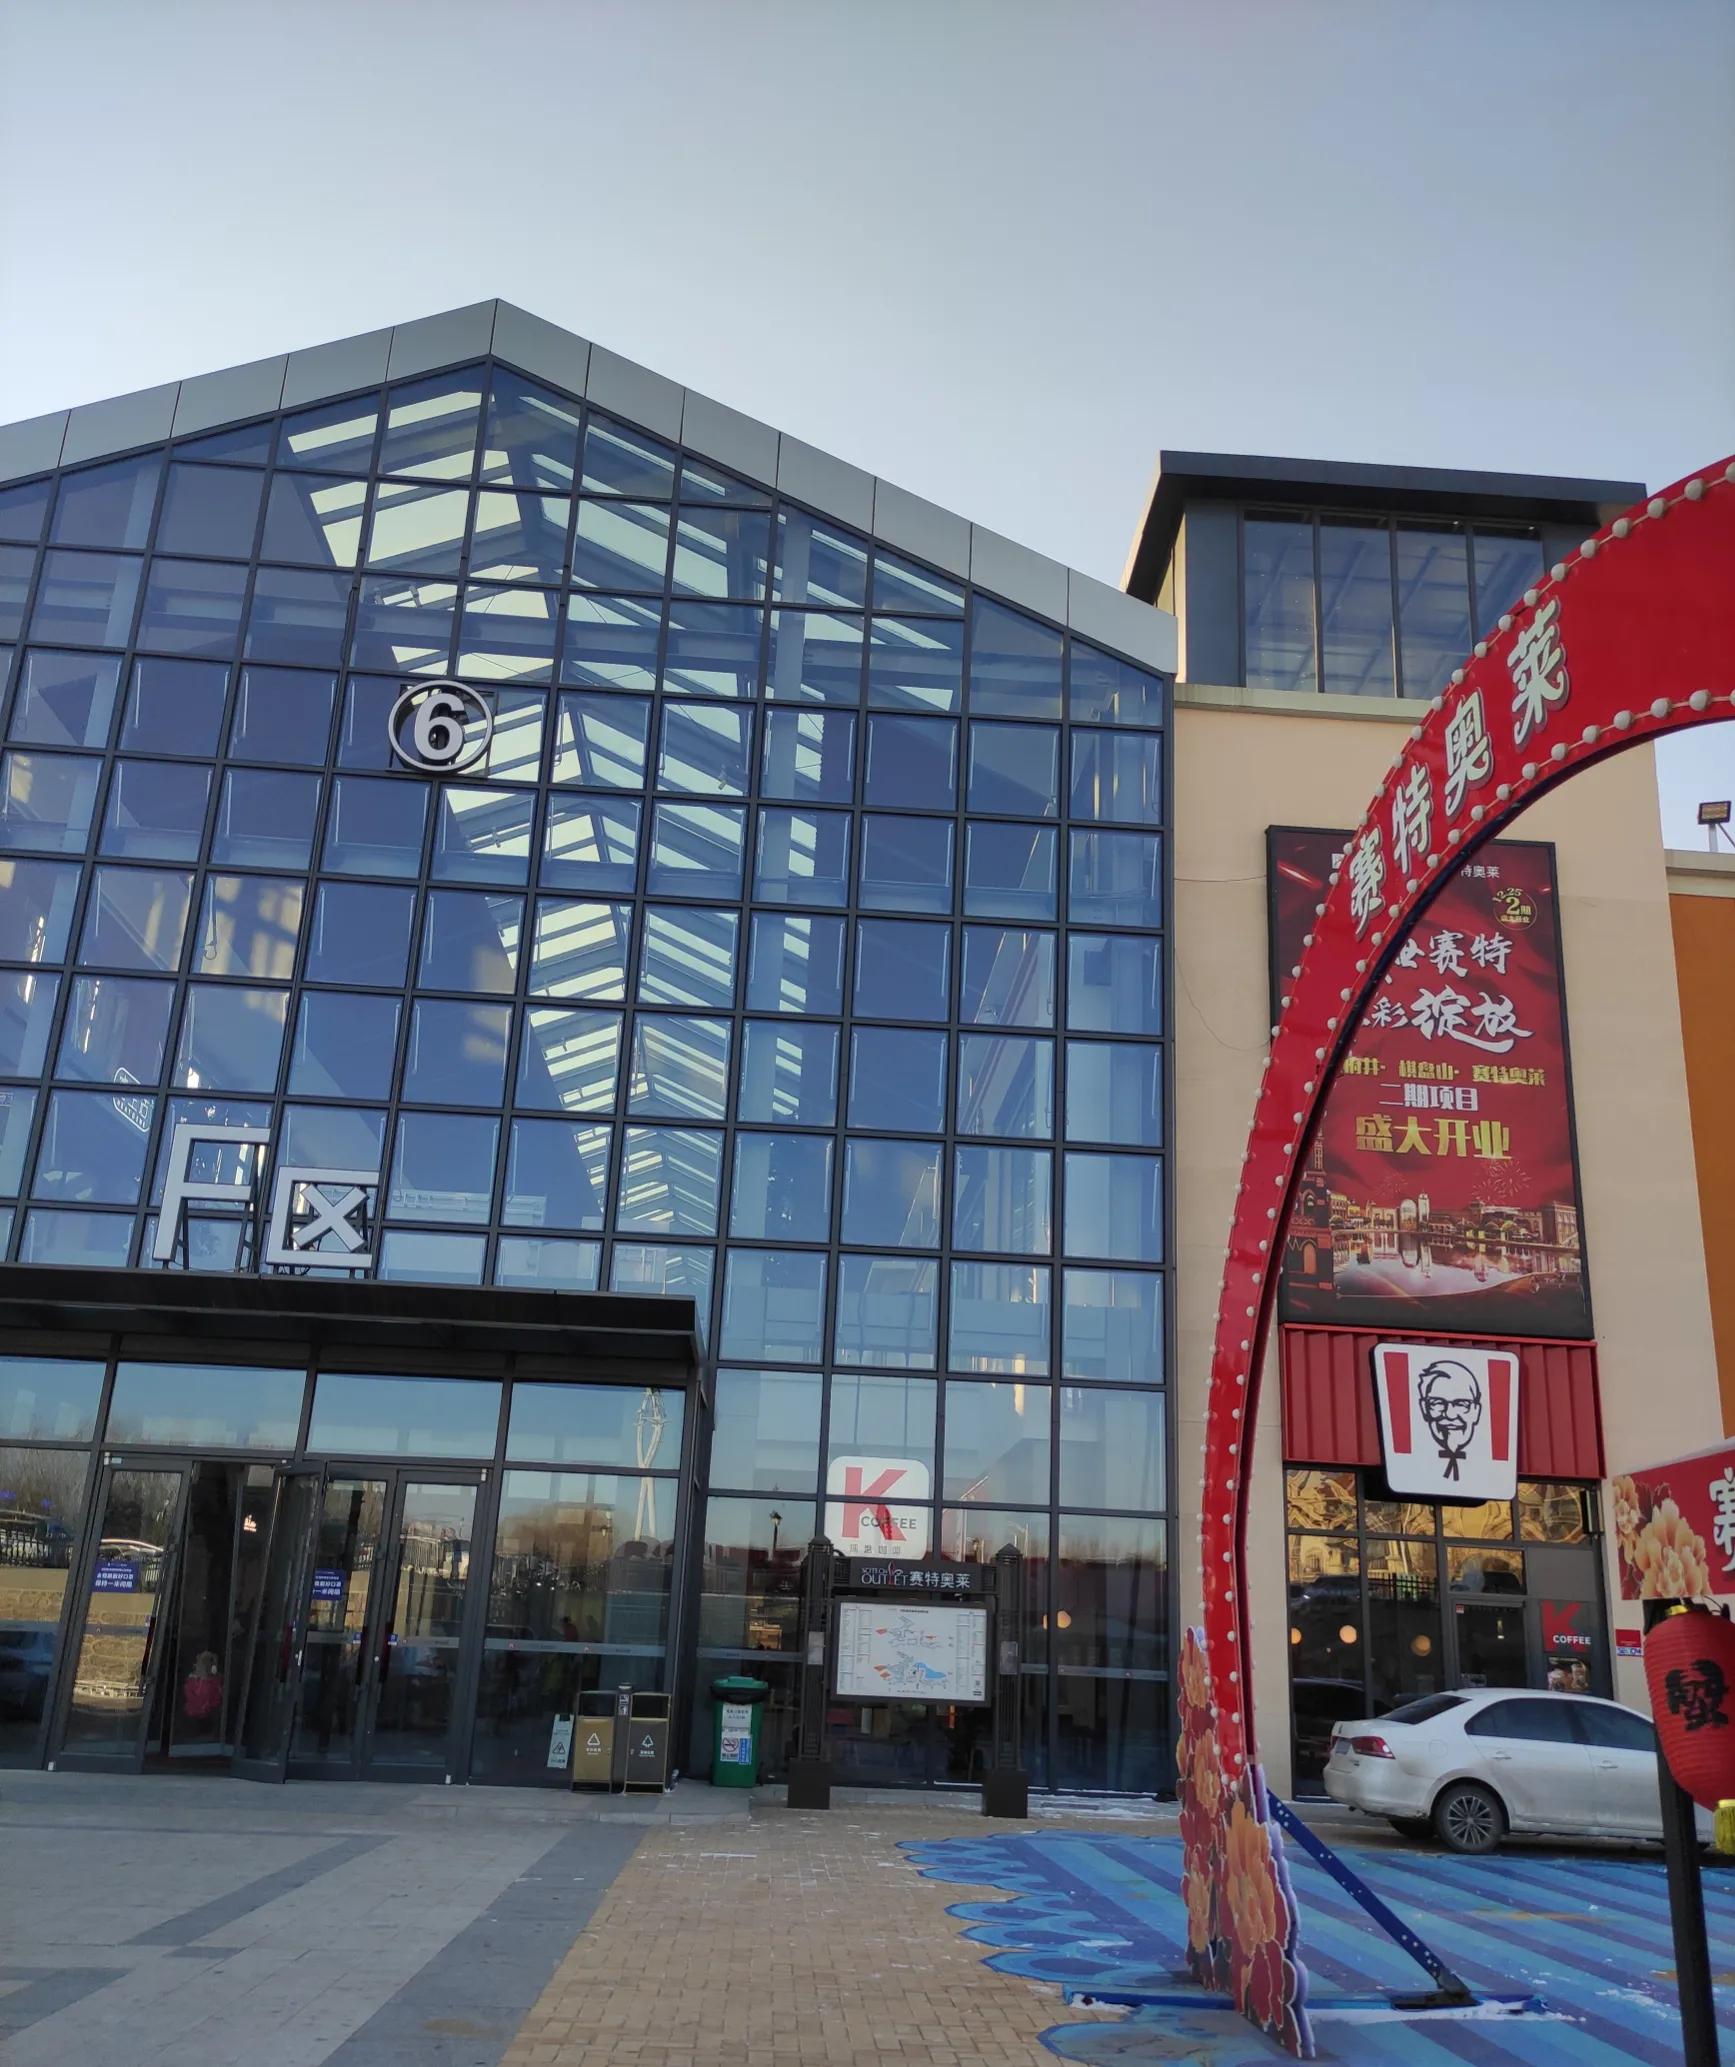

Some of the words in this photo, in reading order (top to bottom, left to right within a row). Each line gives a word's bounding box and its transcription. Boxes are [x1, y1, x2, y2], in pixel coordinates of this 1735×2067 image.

[1350, 599, 1566, 936] 赛特奥莱
[1361, 984, 1534, 1053] 彩绽放
[1379, 1083, 1479, 1112] 二期项目
[1355, 1113, 1513, 1160] 盛大开业
[841, 1466, 908, 1541] K
[860, 1515, 917, 1530] COFFEE
[909, 1570, 971, 1589] 赛特奥莱
[1552, 1634, 1592, 1645] COFFEE
